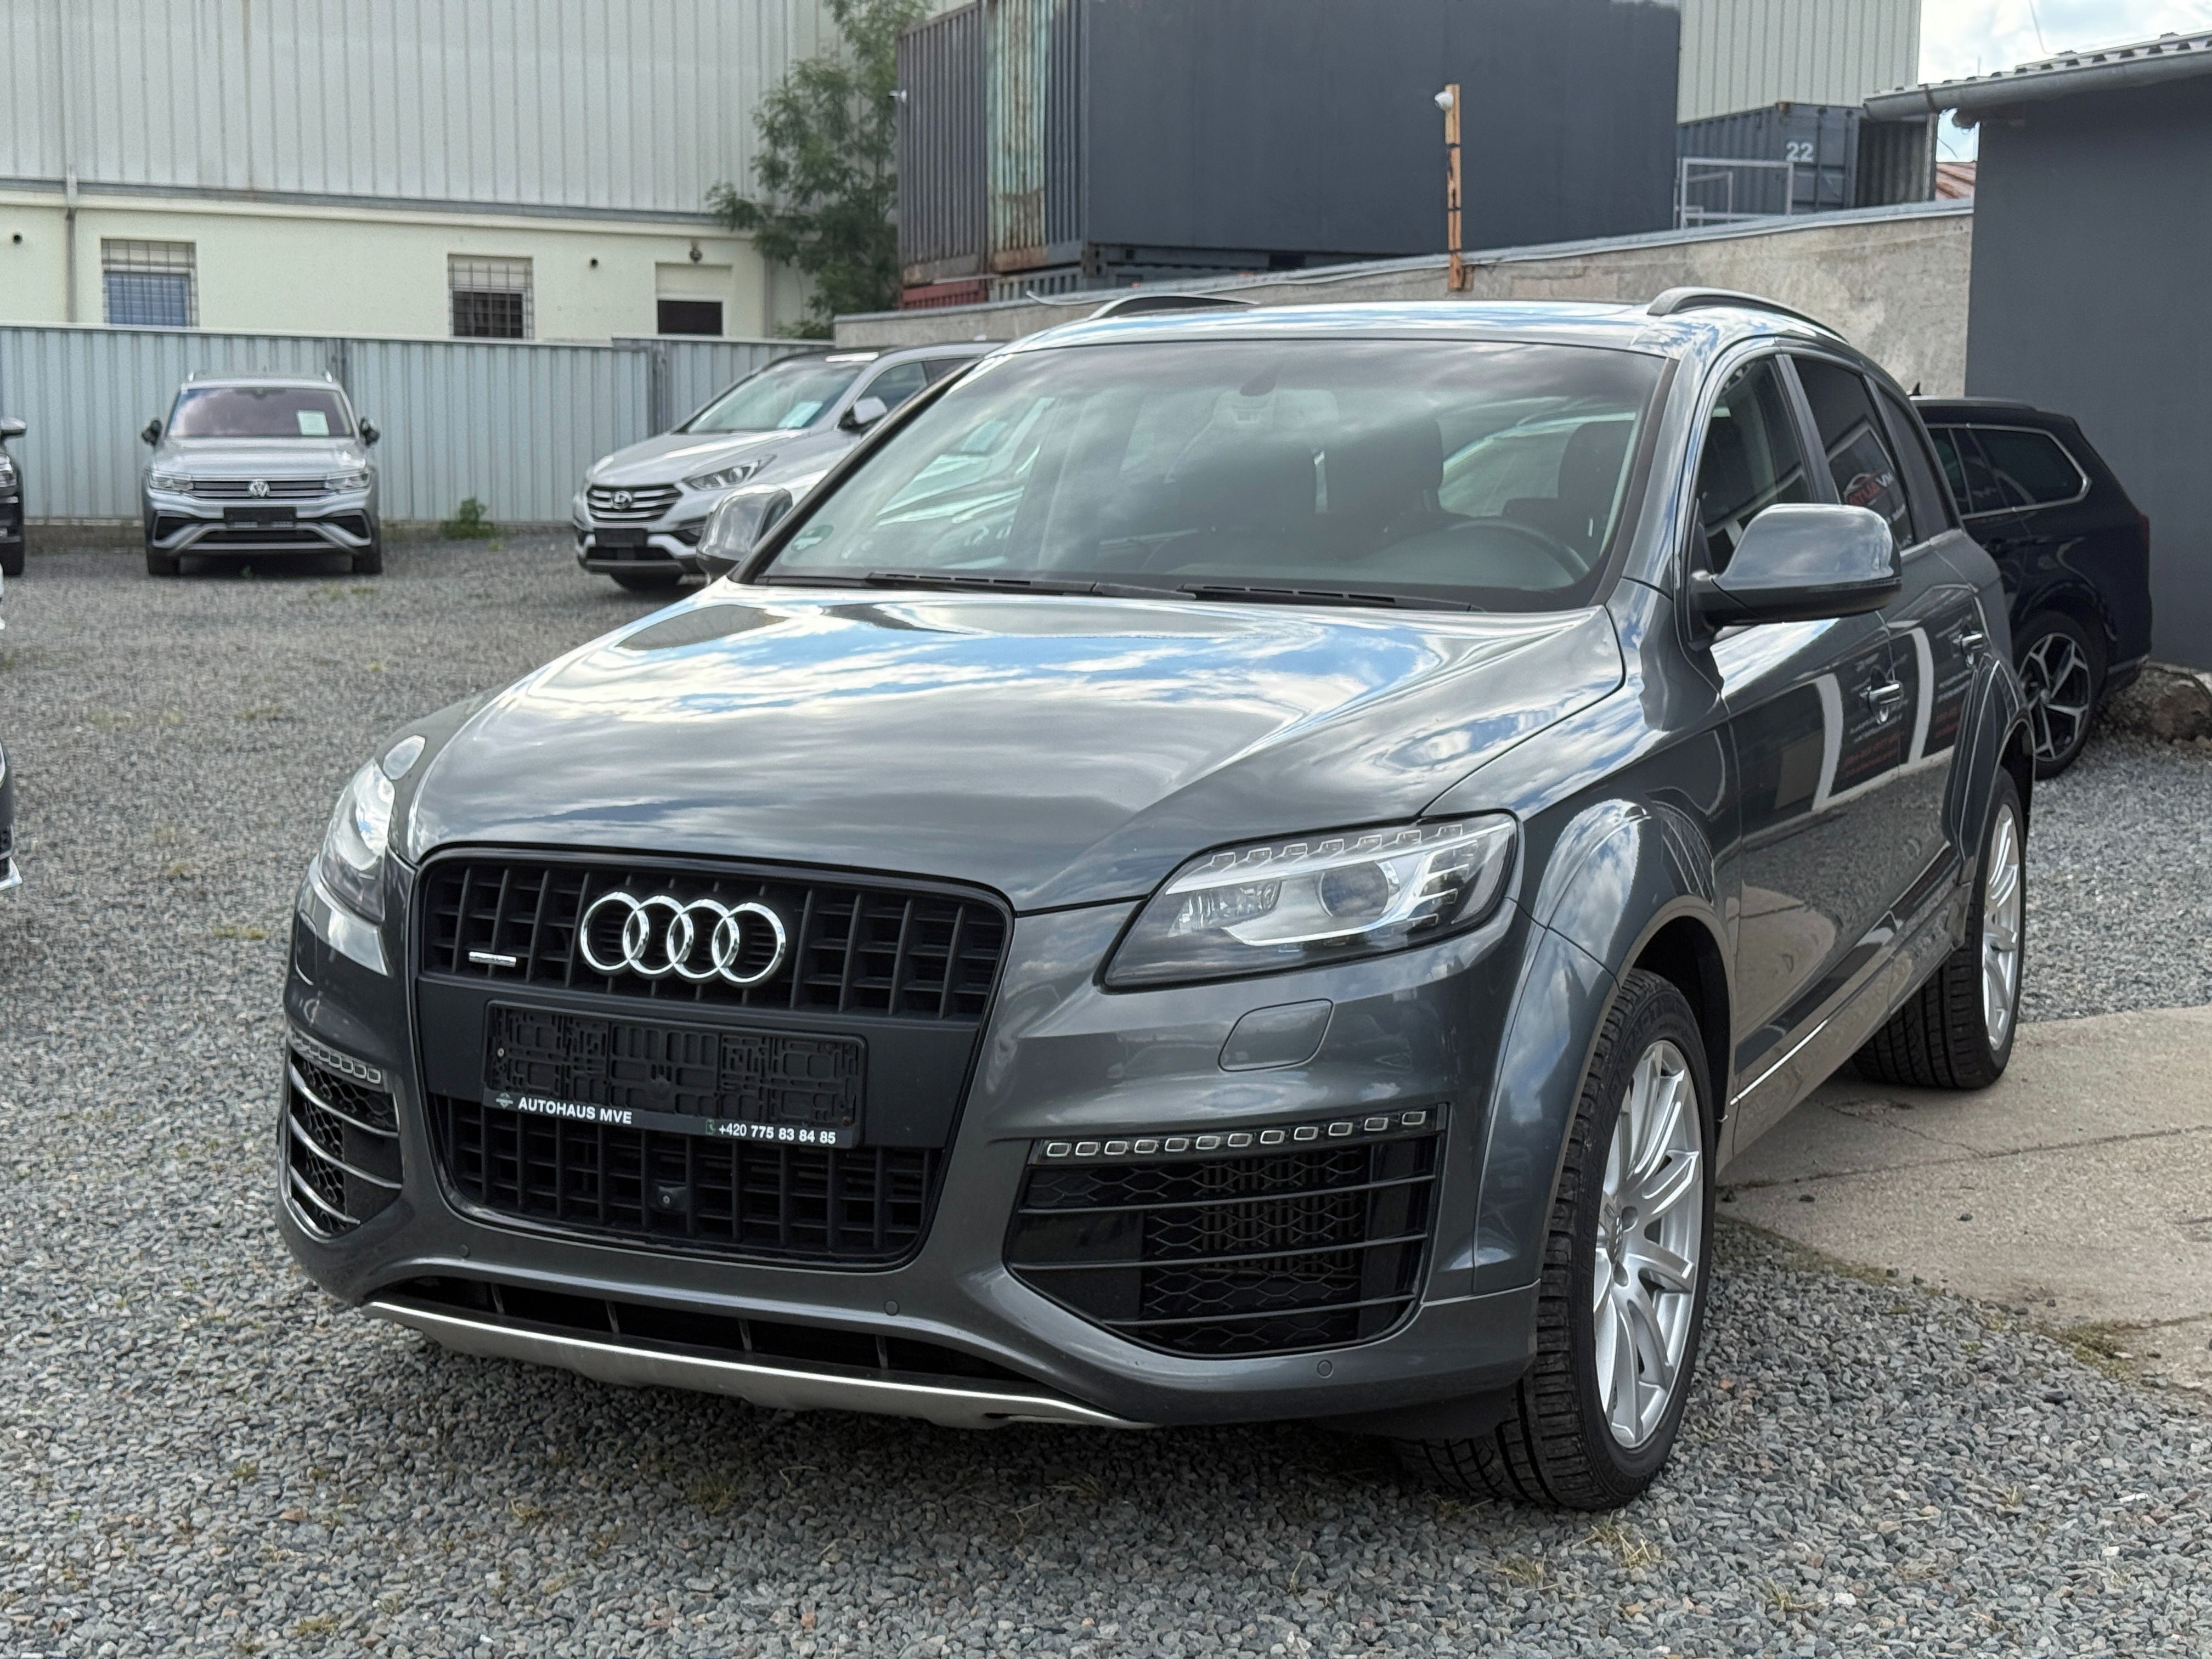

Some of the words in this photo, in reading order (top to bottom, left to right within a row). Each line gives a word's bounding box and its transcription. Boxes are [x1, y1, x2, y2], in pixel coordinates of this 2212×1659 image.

[1786, 142, 1814, 162] 22
[518, 1097, 596, 1120] AUTOHAUS
[600, 1108, 633, 1125] MVE
[719, 1123, 747, 1137] +420
[751, 1125, 774, 1139] 775
[778, 1127, 795, 1141] 83
[799, 1129, 816, 1143] 84
[820, 1131, 836, 1144] 85
